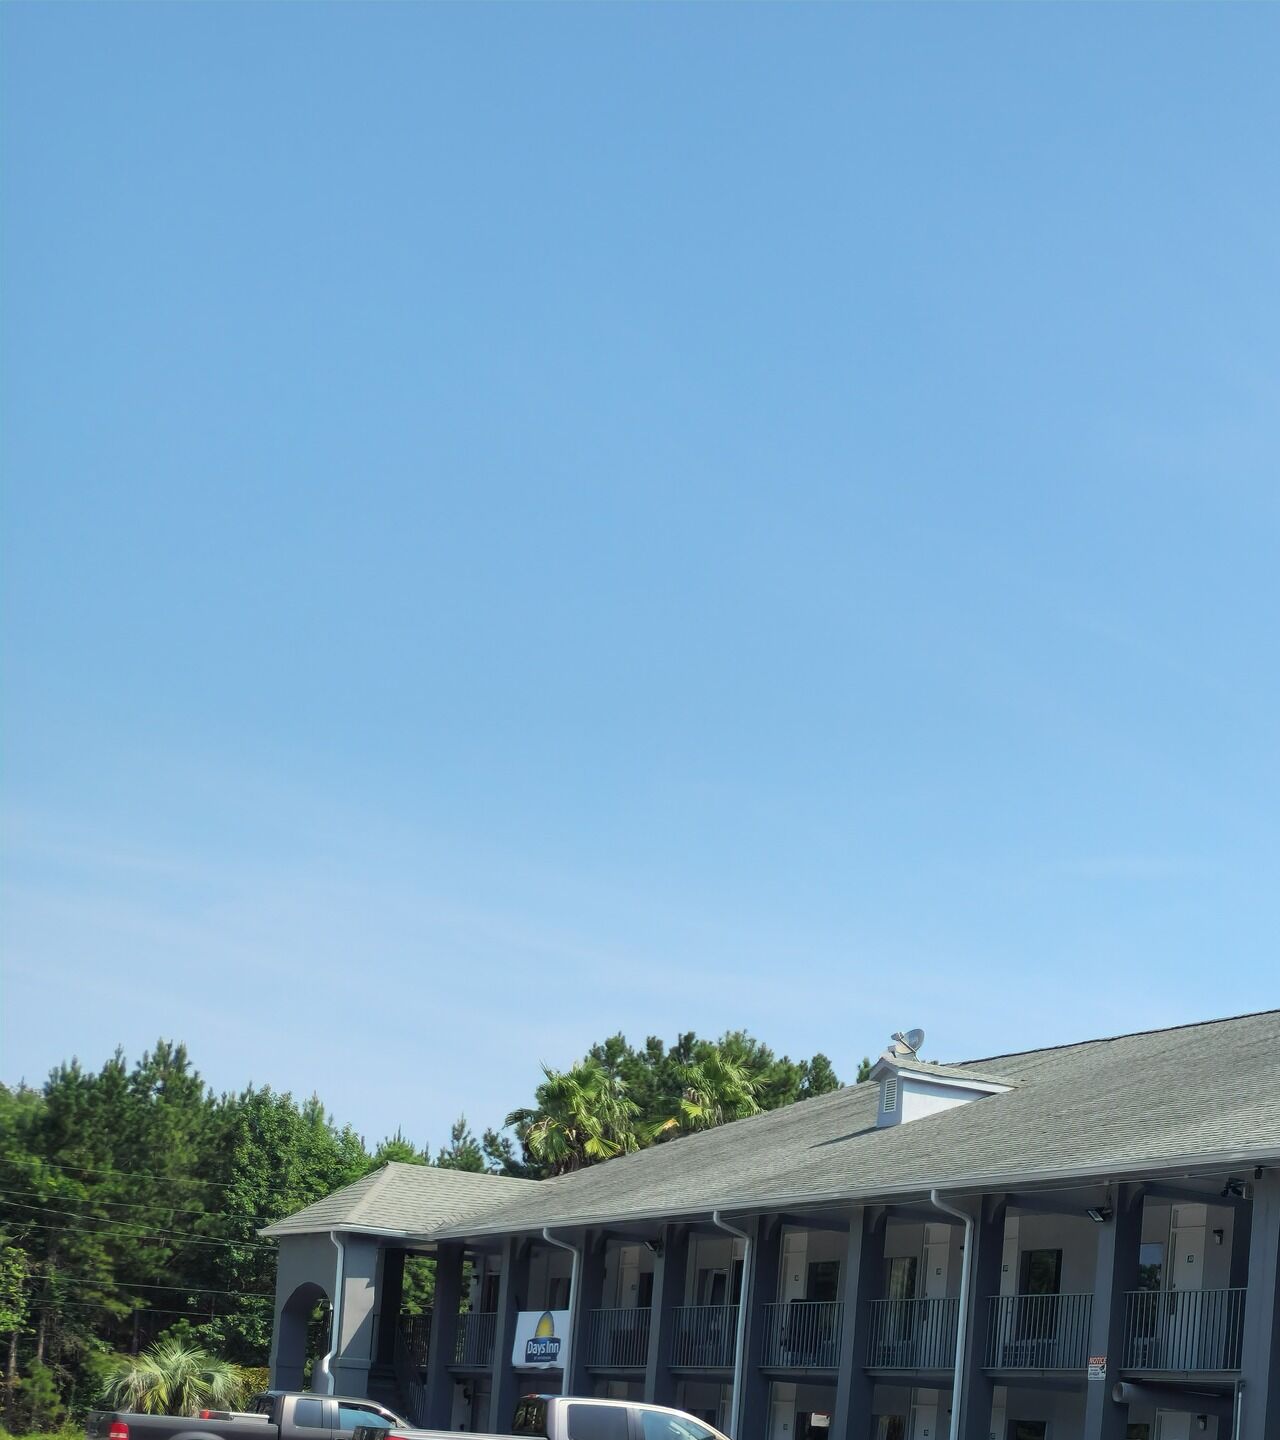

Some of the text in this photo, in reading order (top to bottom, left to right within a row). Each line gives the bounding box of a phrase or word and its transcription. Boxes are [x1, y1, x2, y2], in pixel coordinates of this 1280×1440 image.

[527, 1340, 560, 1356] Days Inn
[1088, 1356, 1107, 1365] NOTICE
